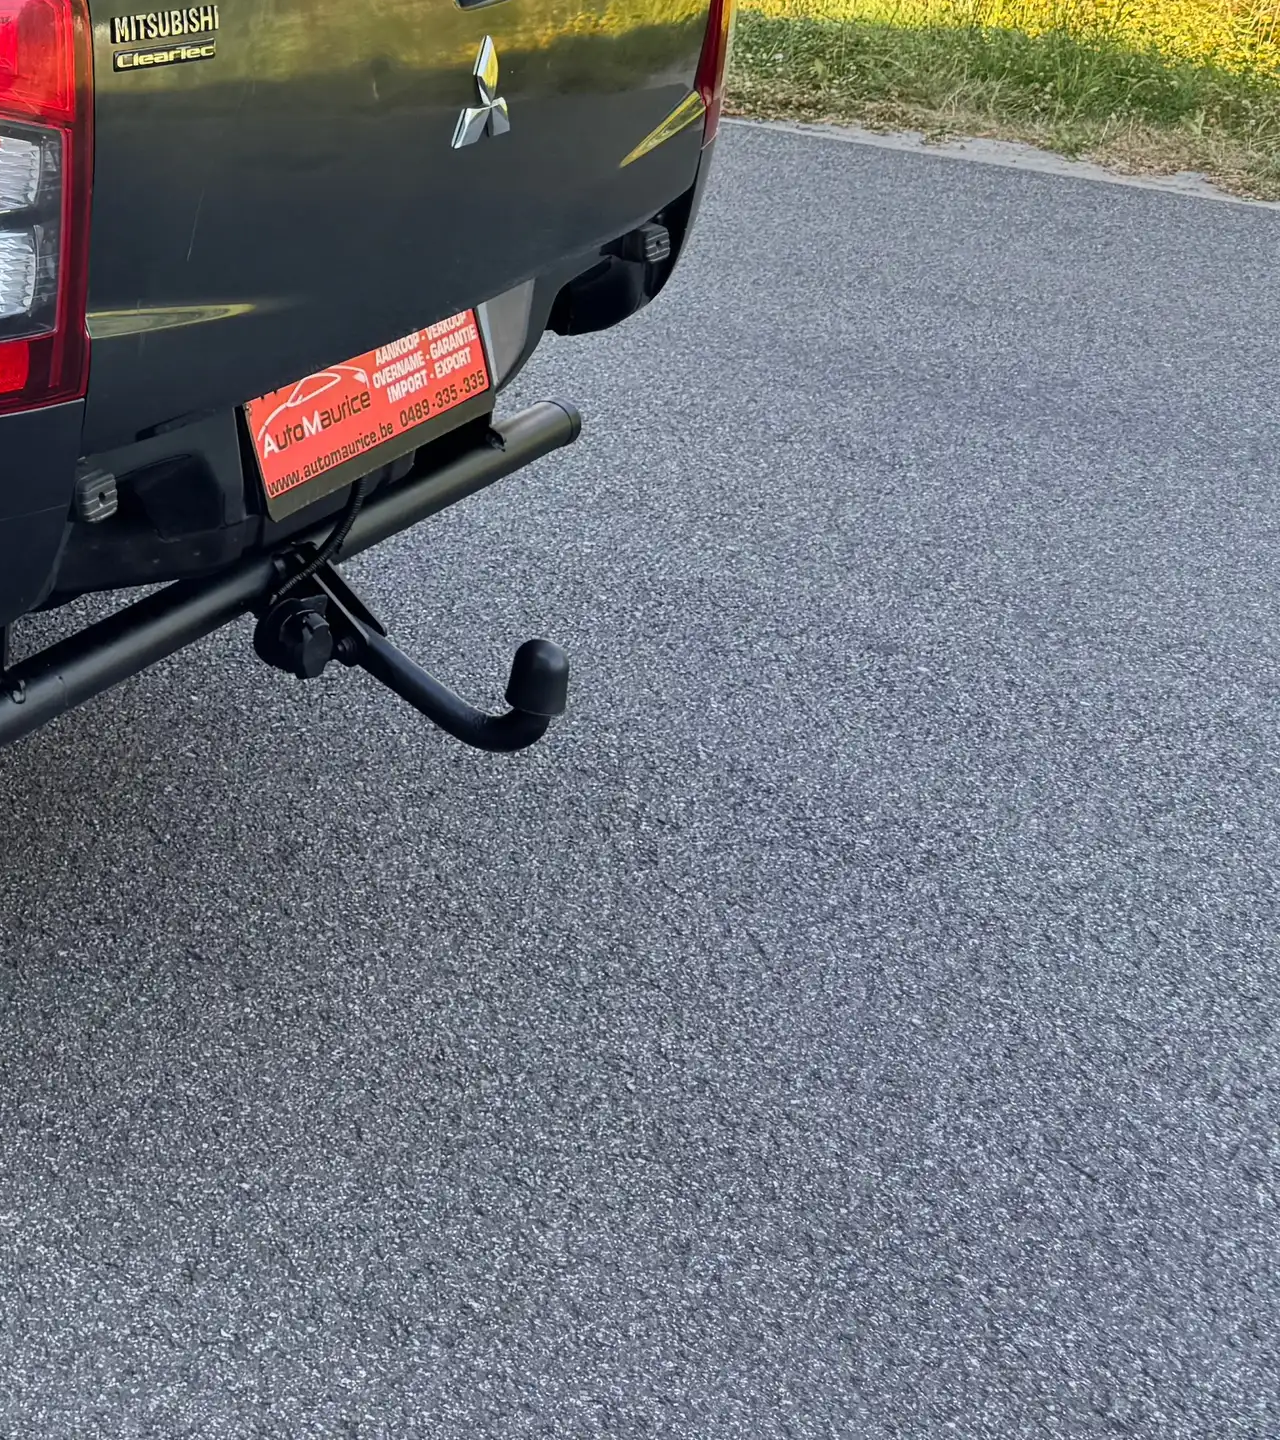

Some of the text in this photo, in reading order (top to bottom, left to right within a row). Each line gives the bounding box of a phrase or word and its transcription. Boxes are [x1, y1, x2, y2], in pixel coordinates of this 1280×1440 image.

[113, 4, 219, 43] MITSUBISHI
[116, 45, 216, 69] ClearTec
[372, 351, 426, 389] OVERNAME
[429, 323, 479, 360] GARANTIE
[375, 333, 420, 367] AANKOOP
[386, 369, 428, 404] IMPORT
[434, 346, 471, 379] EXPORT
[263, 390, 371, 459] AutoMaurice
[267, 422, 394, 496] www.automaurice.be
